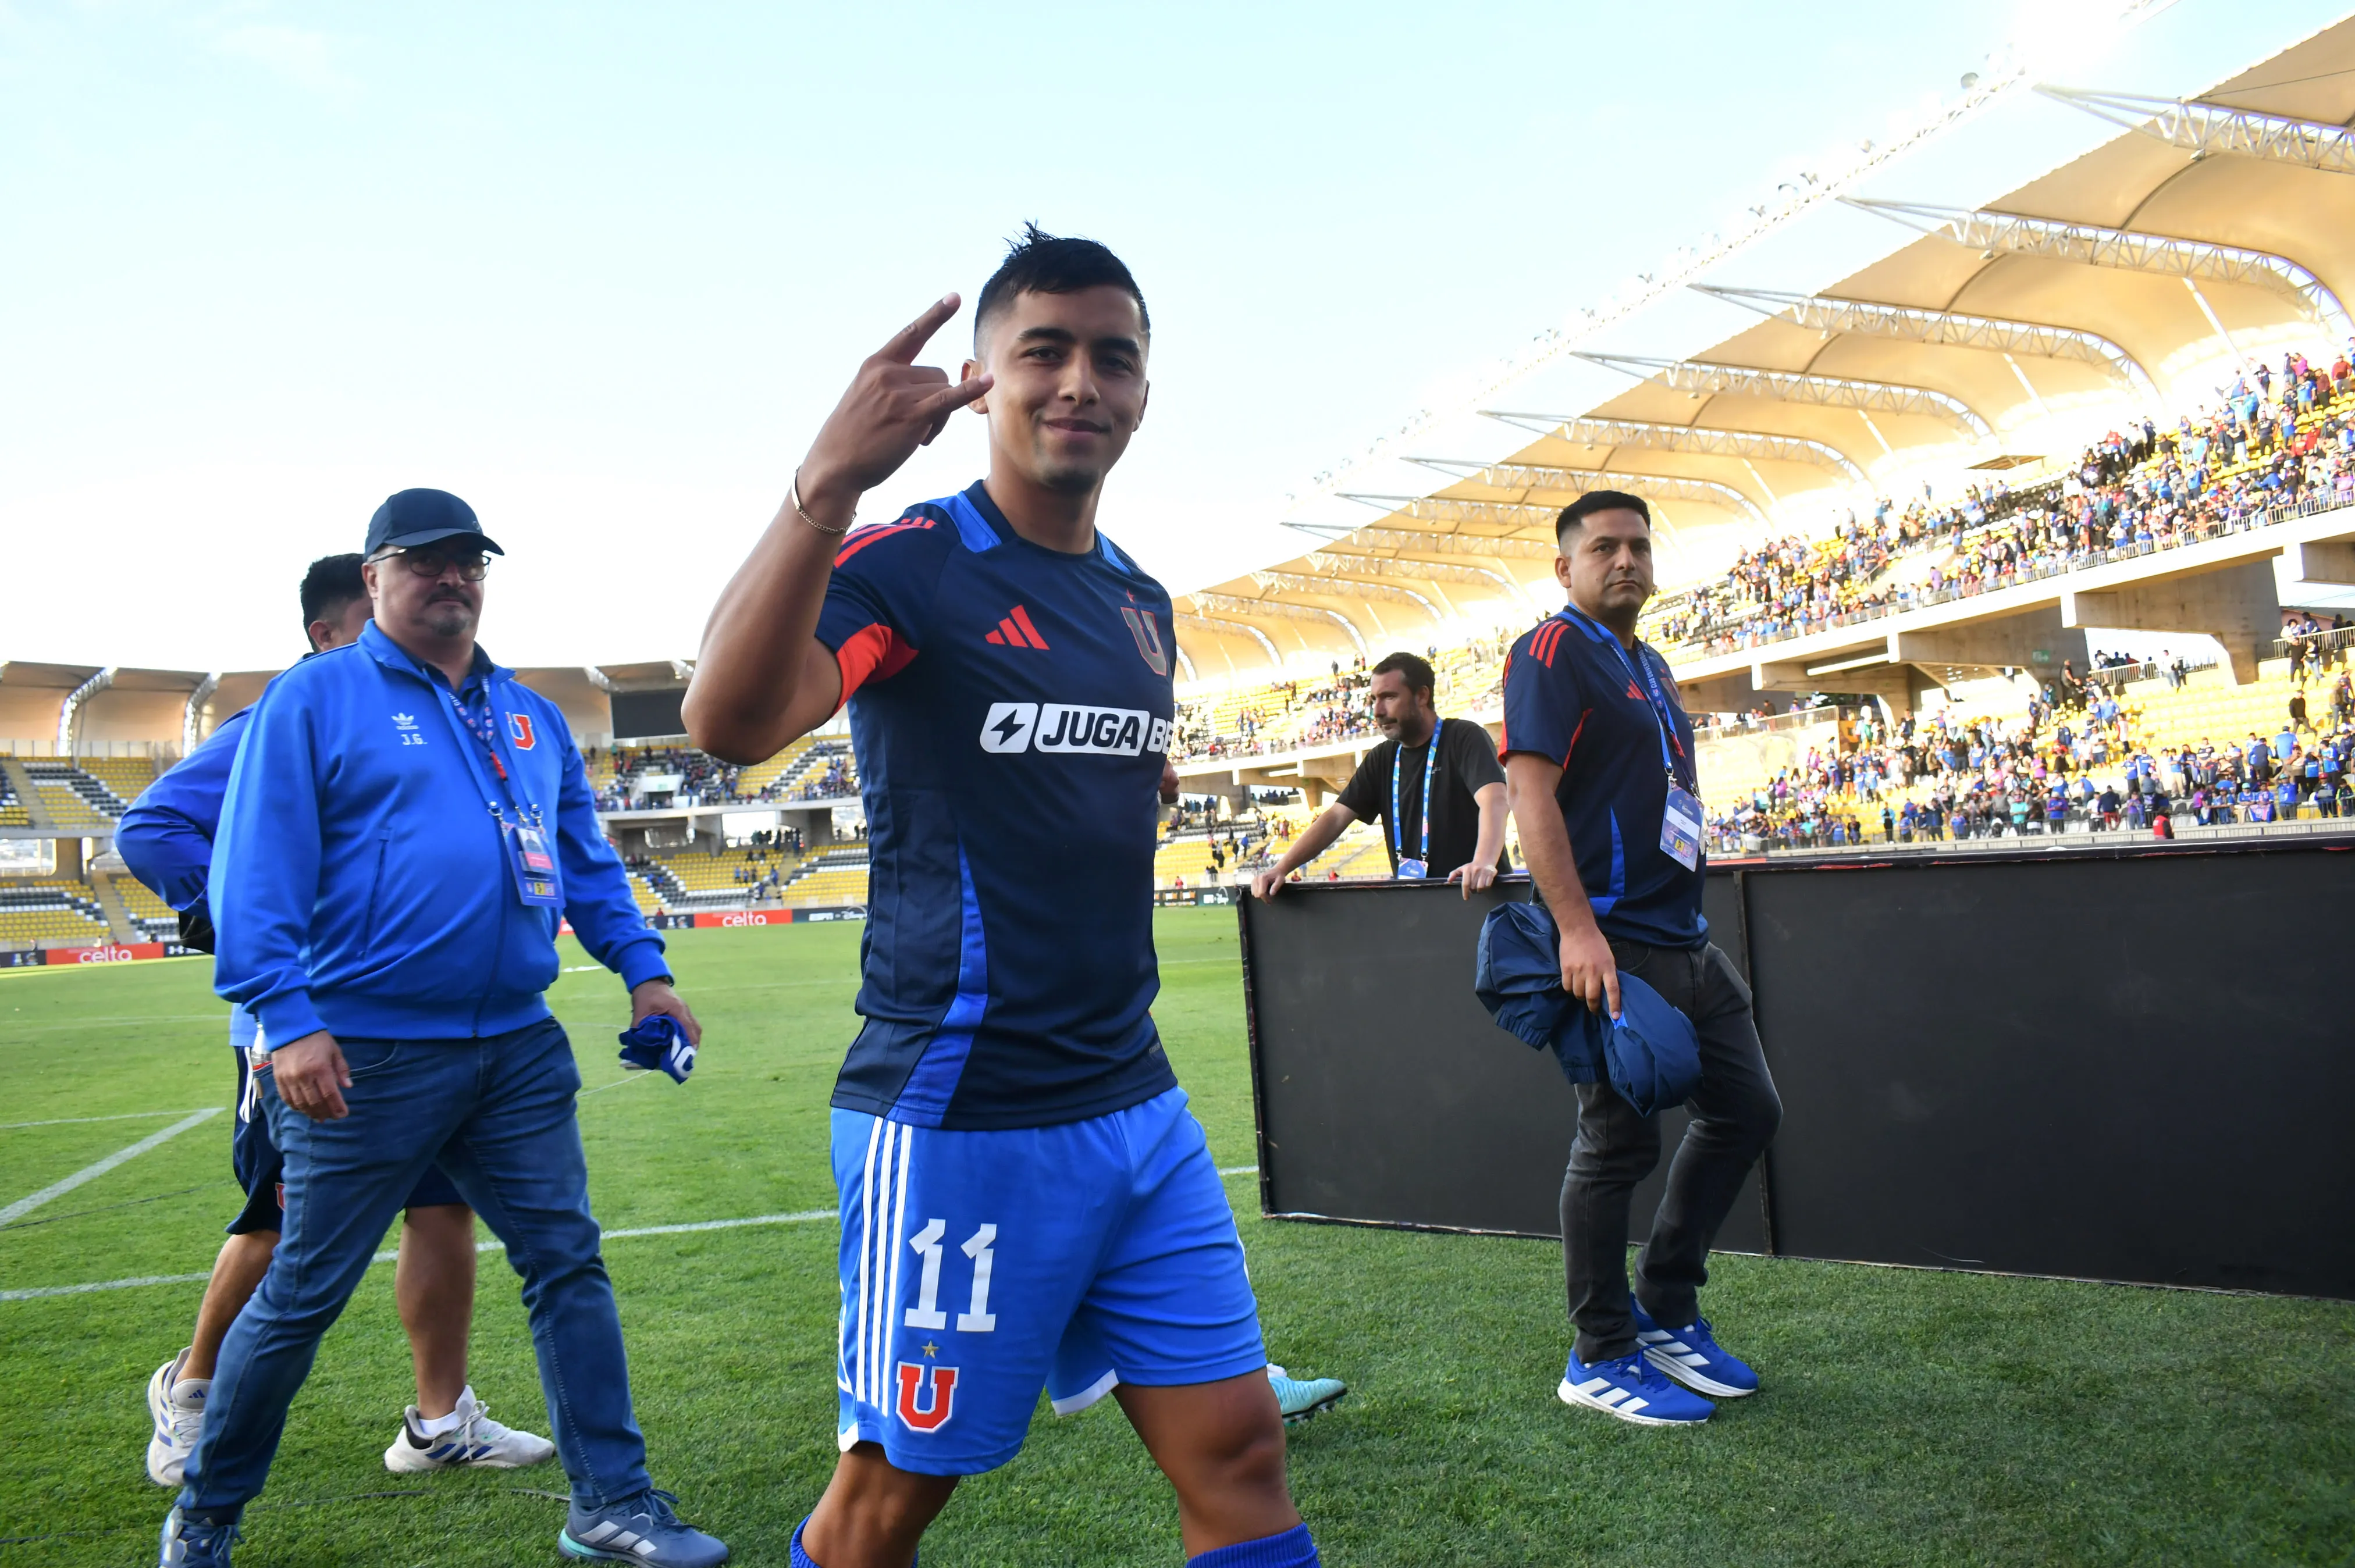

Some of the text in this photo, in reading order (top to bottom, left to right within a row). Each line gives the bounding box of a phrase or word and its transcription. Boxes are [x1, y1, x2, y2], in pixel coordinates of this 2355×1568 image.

[1120, 607, 1166, 676] U
[904, 1218, 997, 1332] 11
[896, 1361, 959, 1432] U
